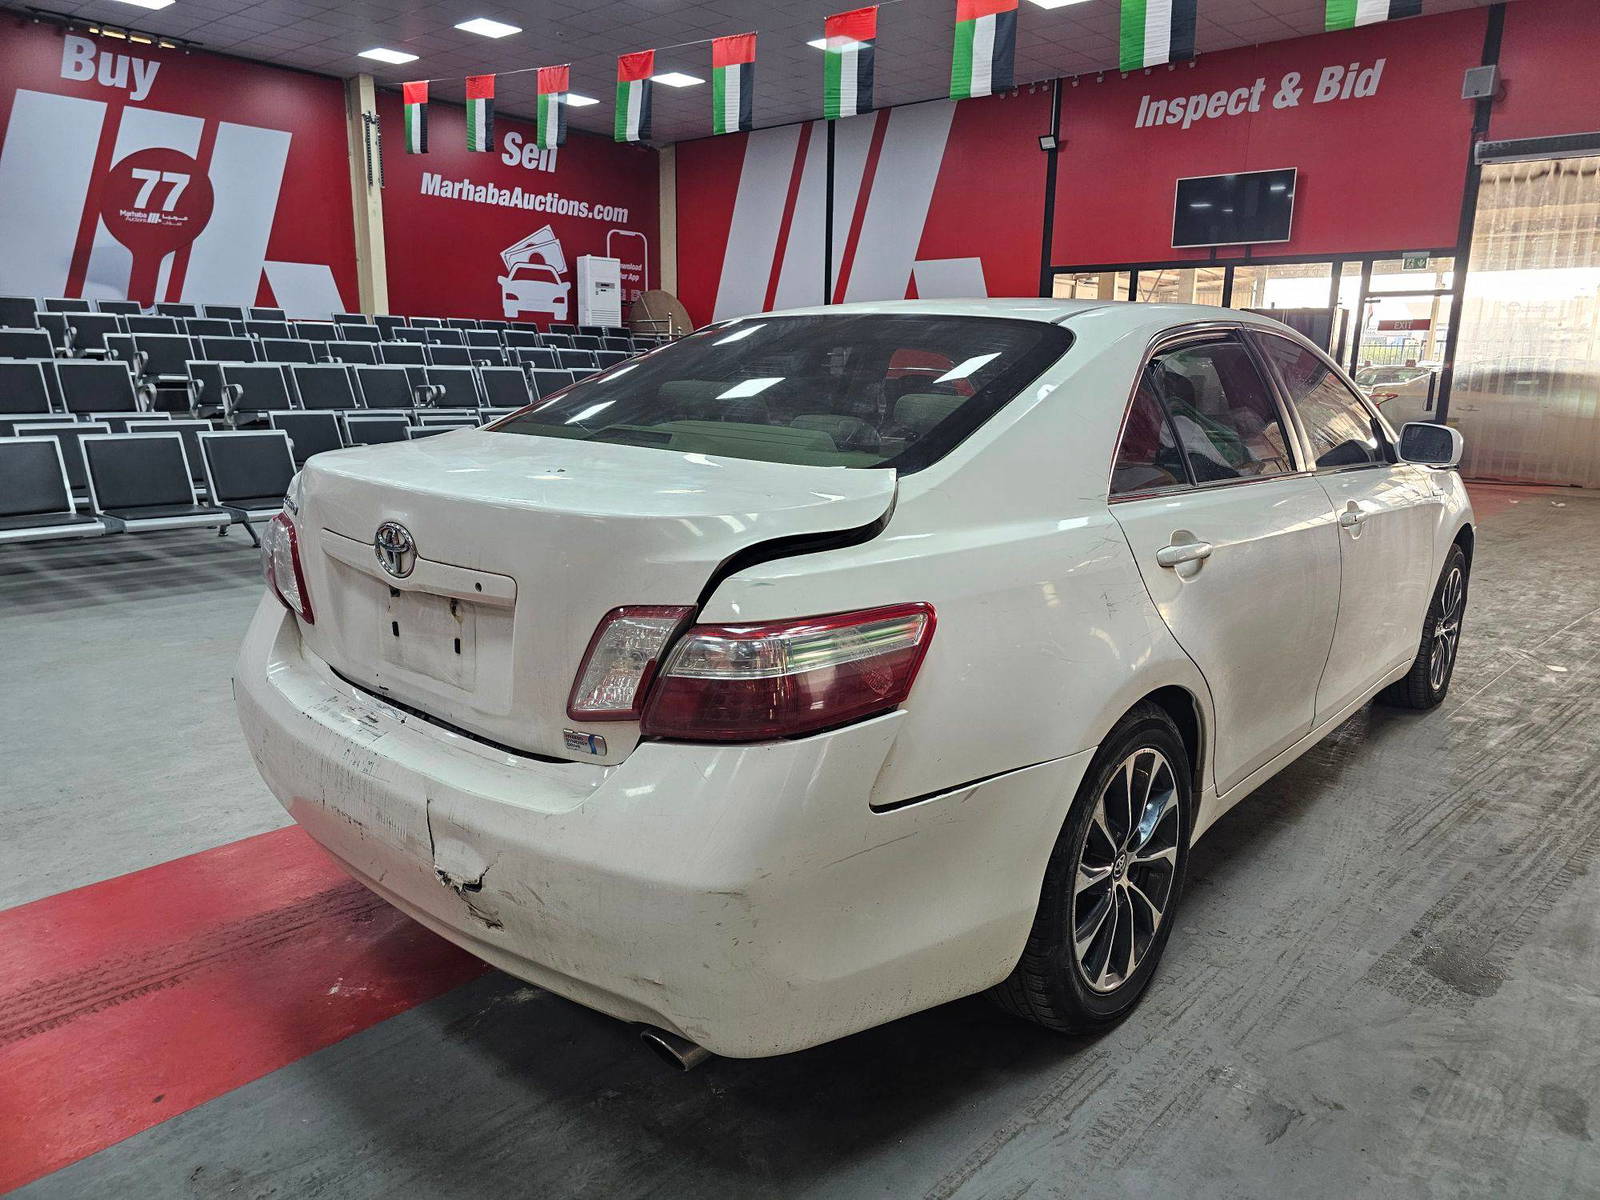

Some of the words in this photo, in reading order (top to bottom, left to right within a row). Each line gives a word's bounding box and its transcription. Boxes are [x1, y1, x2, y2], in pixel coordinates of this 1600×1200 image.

[60, 34, 161, 101] Buy
[1134, 78, 1266, 130] Inspect
[1272, 71, 1303, 110] &
[1313, 58, 1387, 104] Bid
[501, 131, 558, 173] Sell
[131, 168, 191, 211] 77
[420, 172, 629, 224] MarhabaAuctions.com
[628, 273, 640, 282] App
[1393, 321, 1412, 329] EXIT
